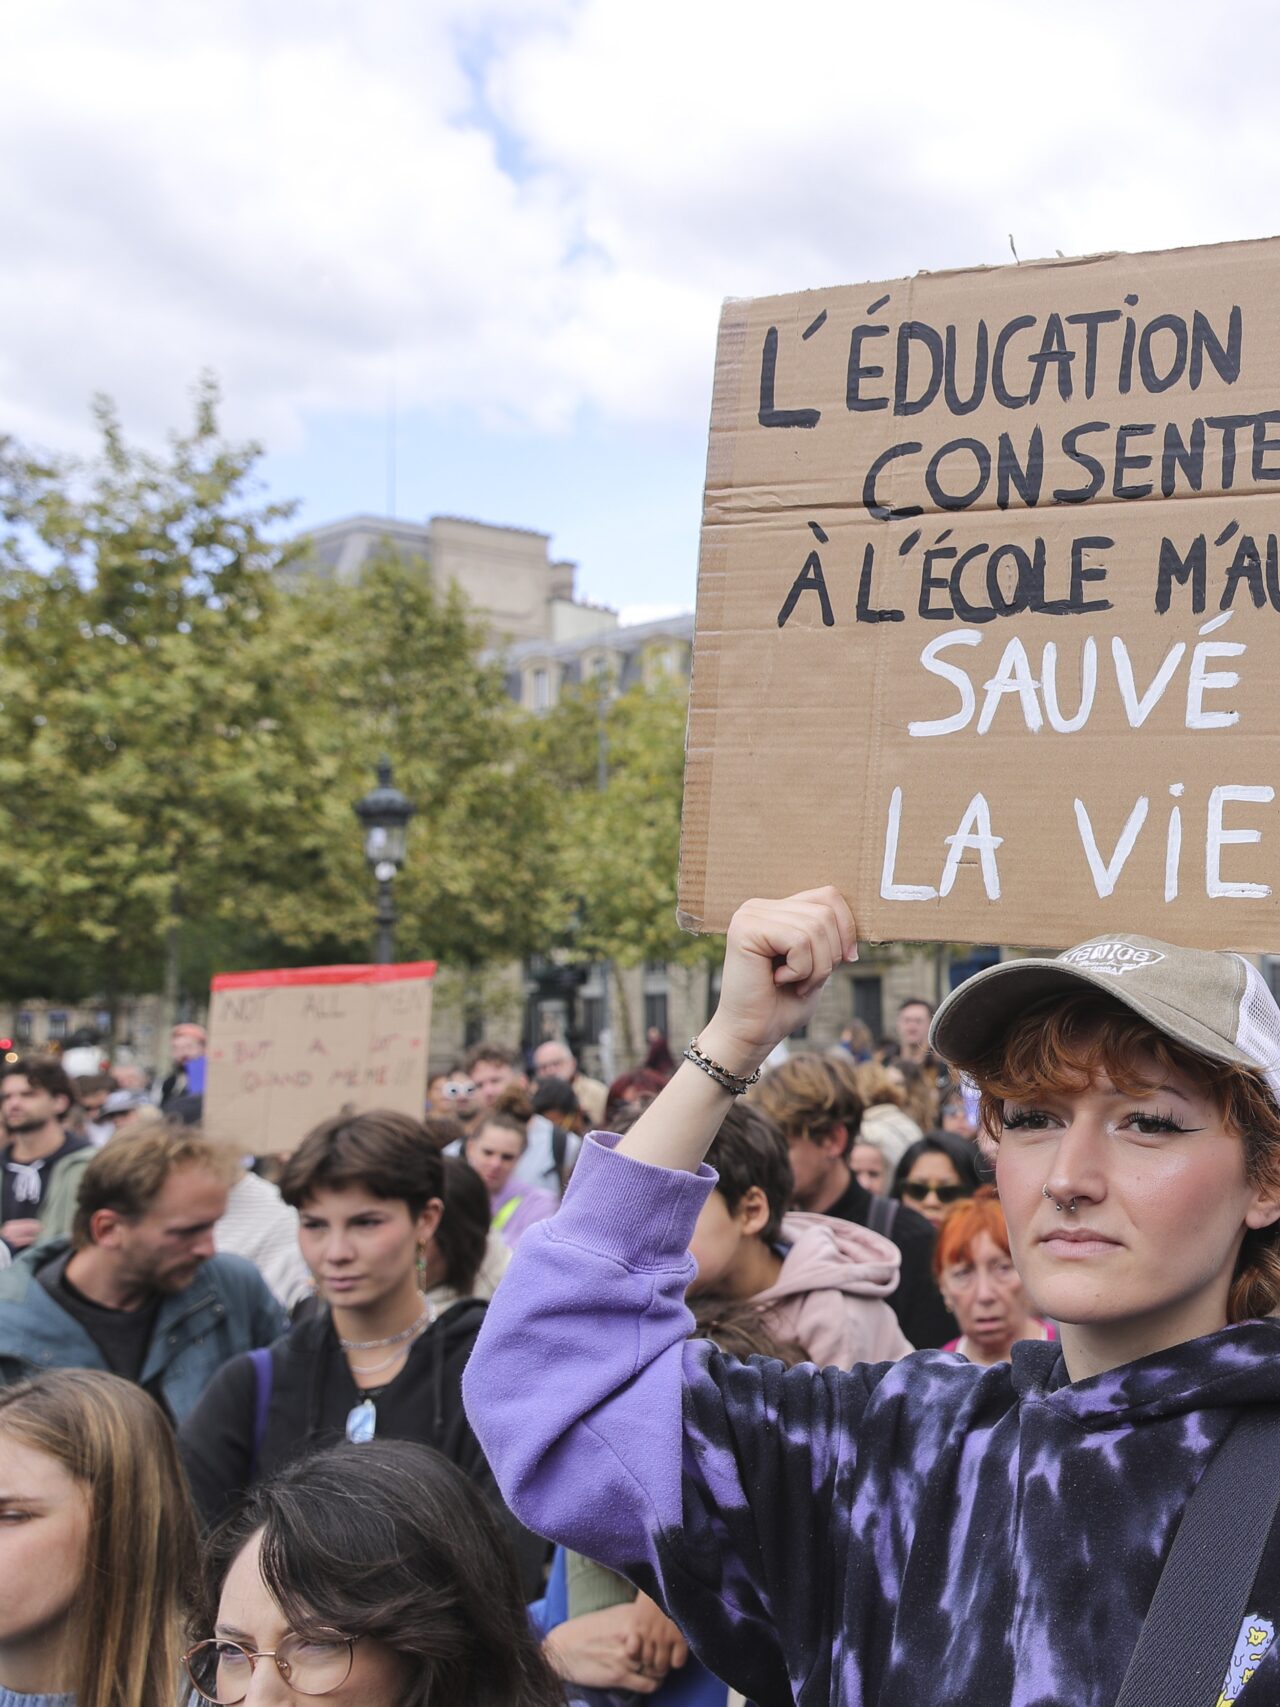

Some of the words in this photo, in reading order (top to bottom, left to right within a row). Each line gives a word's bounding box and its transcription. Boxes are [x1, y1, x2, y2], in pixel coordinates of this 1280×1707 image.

[777, 519, 836, 629] À
[855, 528, 1117, 625] L'ÉCOLE
[906, 609, 1249, 738] SAUVÉ
[879, 784, 1006, 903] LA
